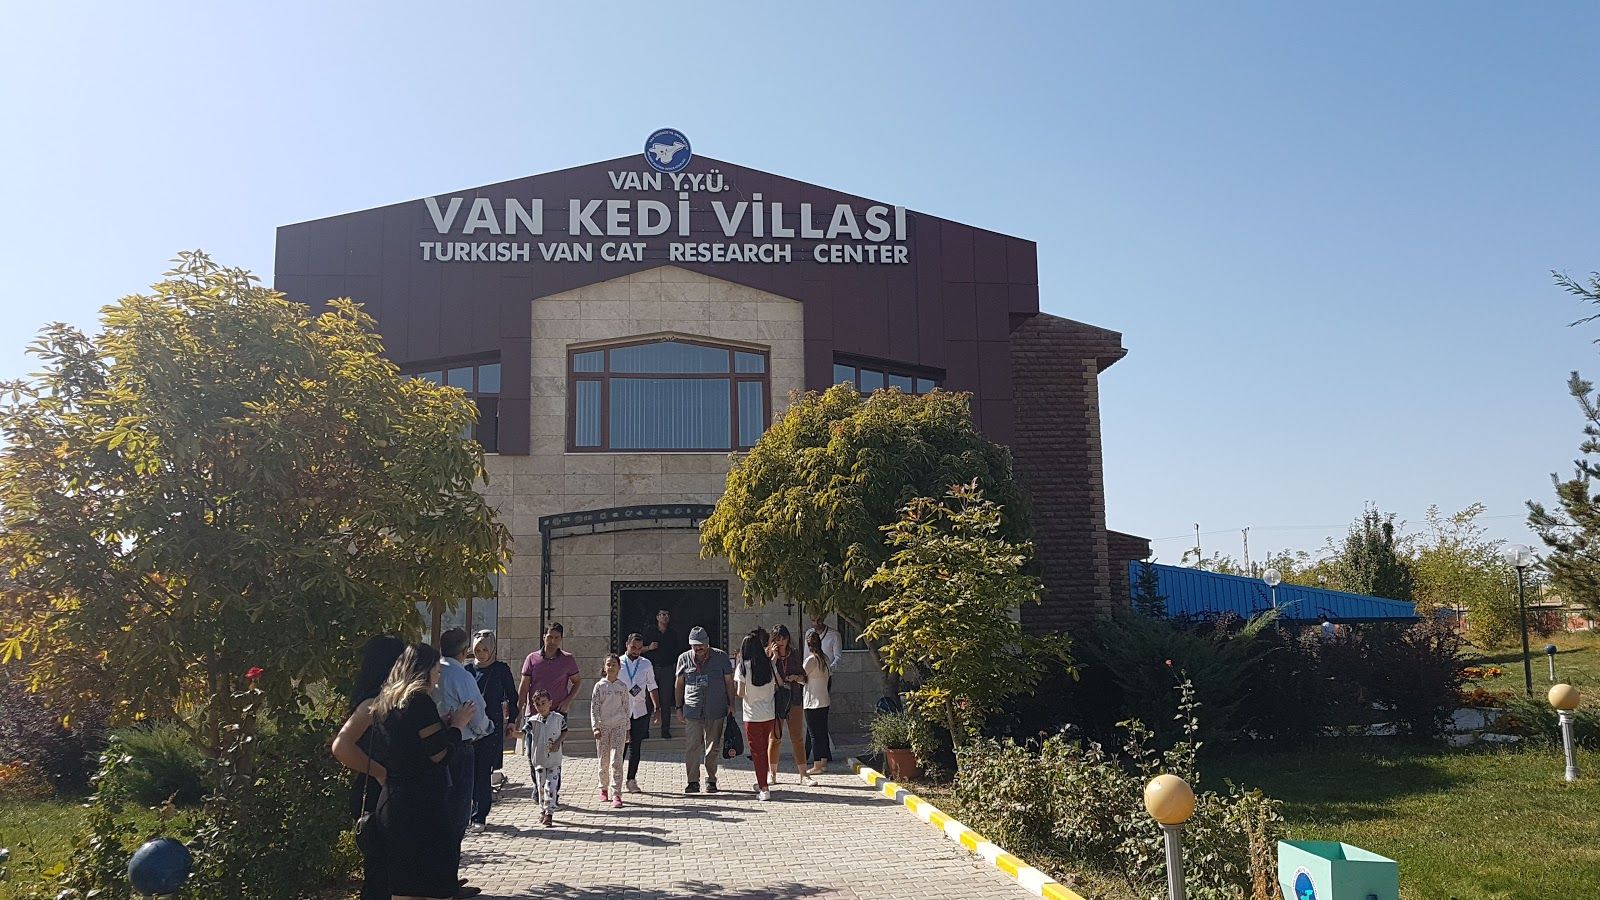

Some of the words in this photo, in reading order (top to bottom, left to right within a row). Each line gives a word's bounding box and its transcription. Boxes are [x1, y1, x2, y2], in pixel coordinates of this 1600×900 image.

[608, 171, 662, 191] VAN
[669, 169, 729, 192] Y.Y.Ü.
[424, 197, 543, 235] VAN
[569, 192, 690, 237] KEDİ
[711, 193, 907, 242] VİLLASI
[420, 242, 530, 262] TURKISH
[538, 242, 593, 262] VAN
[600, 242, 647, 262] CAT
[669, 242, 791, 263] RESEARCH
[813, 244, 908, 264] CENTER
